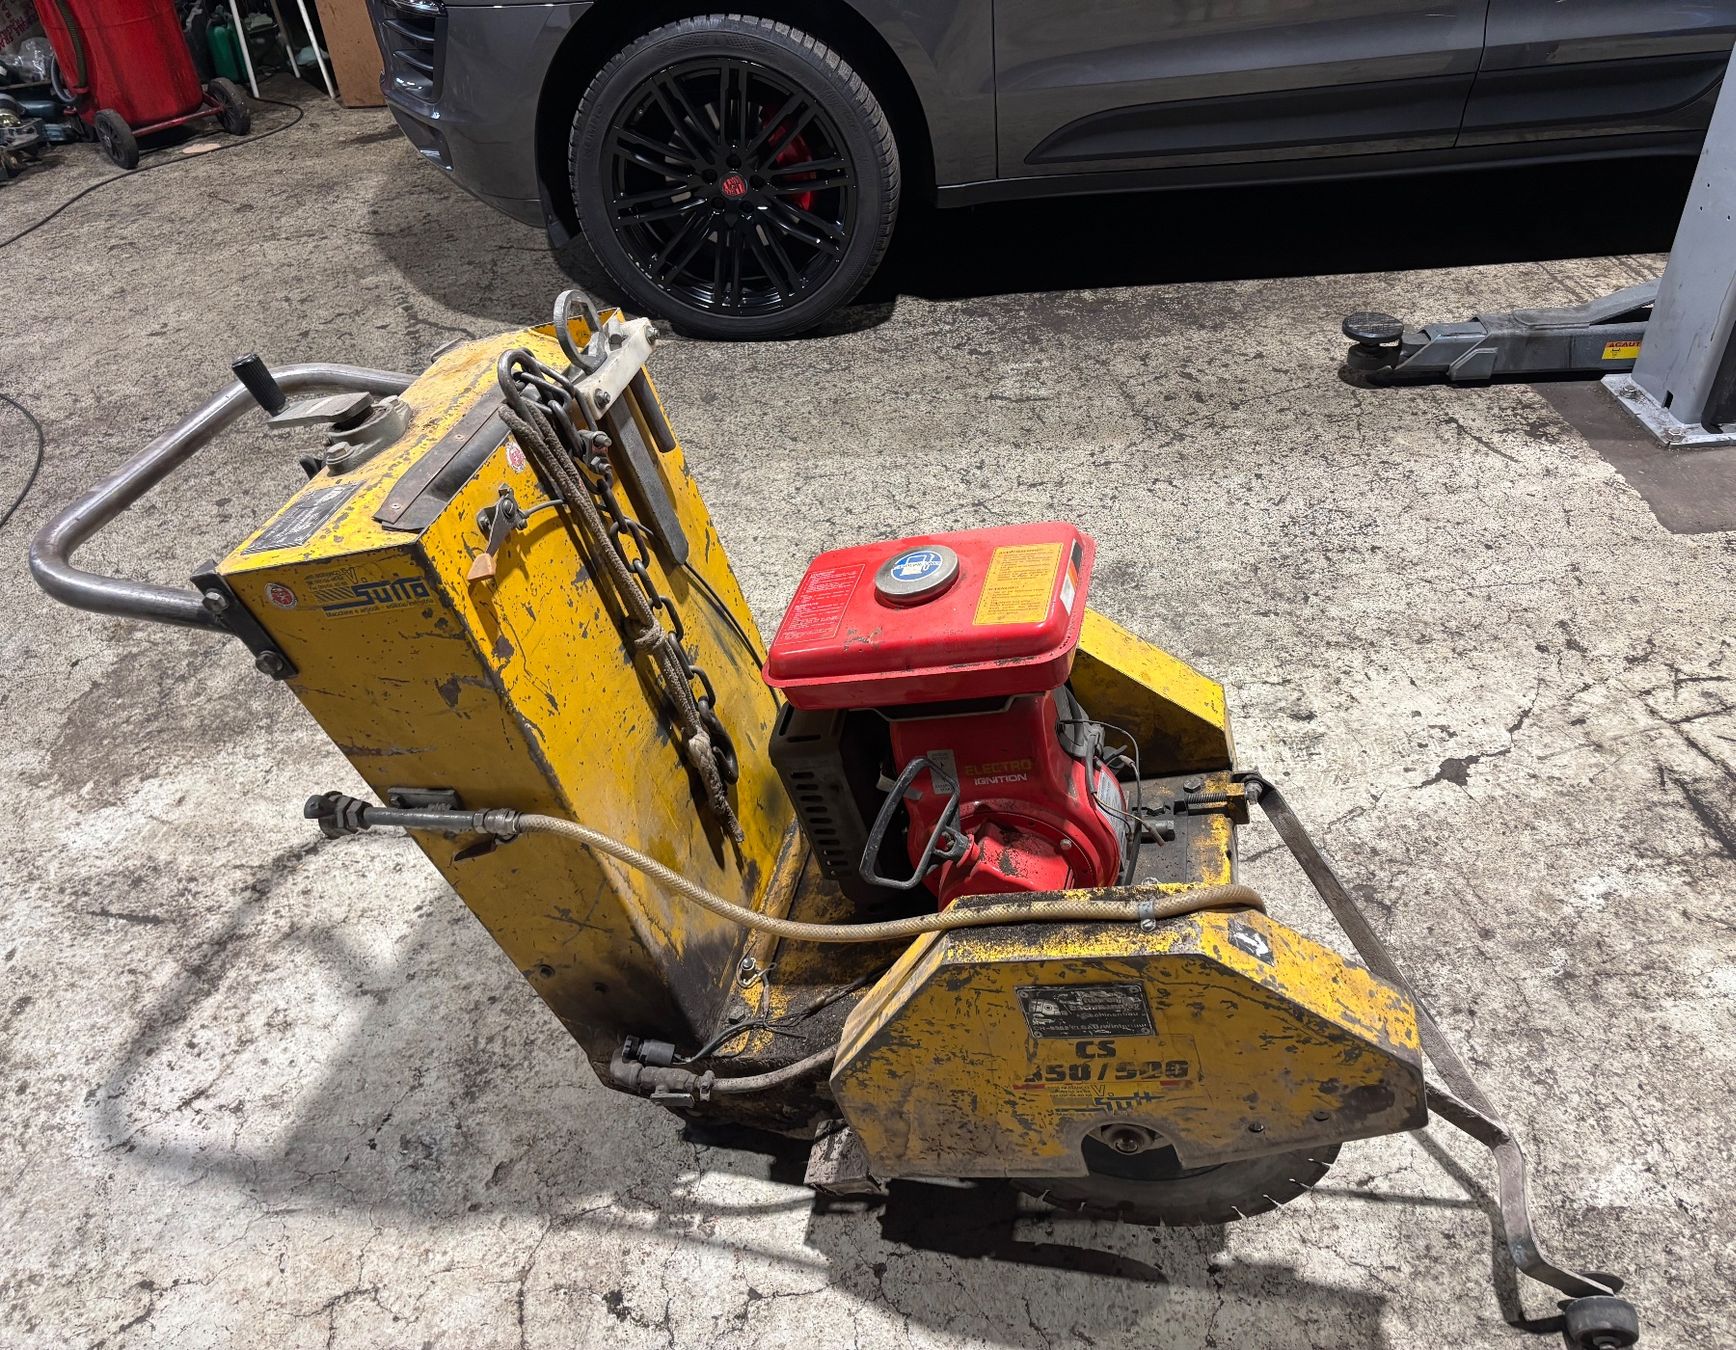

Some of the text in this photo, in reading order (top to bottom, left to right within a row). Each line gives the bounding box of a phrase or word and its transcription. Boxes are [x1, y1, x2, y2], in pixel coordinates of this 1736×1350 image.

[964, 759, 1032, 776] ELECTRO
[974, 773, 1028, 786] IGNITION
[1075, 1040, 1117, 1059] CS
